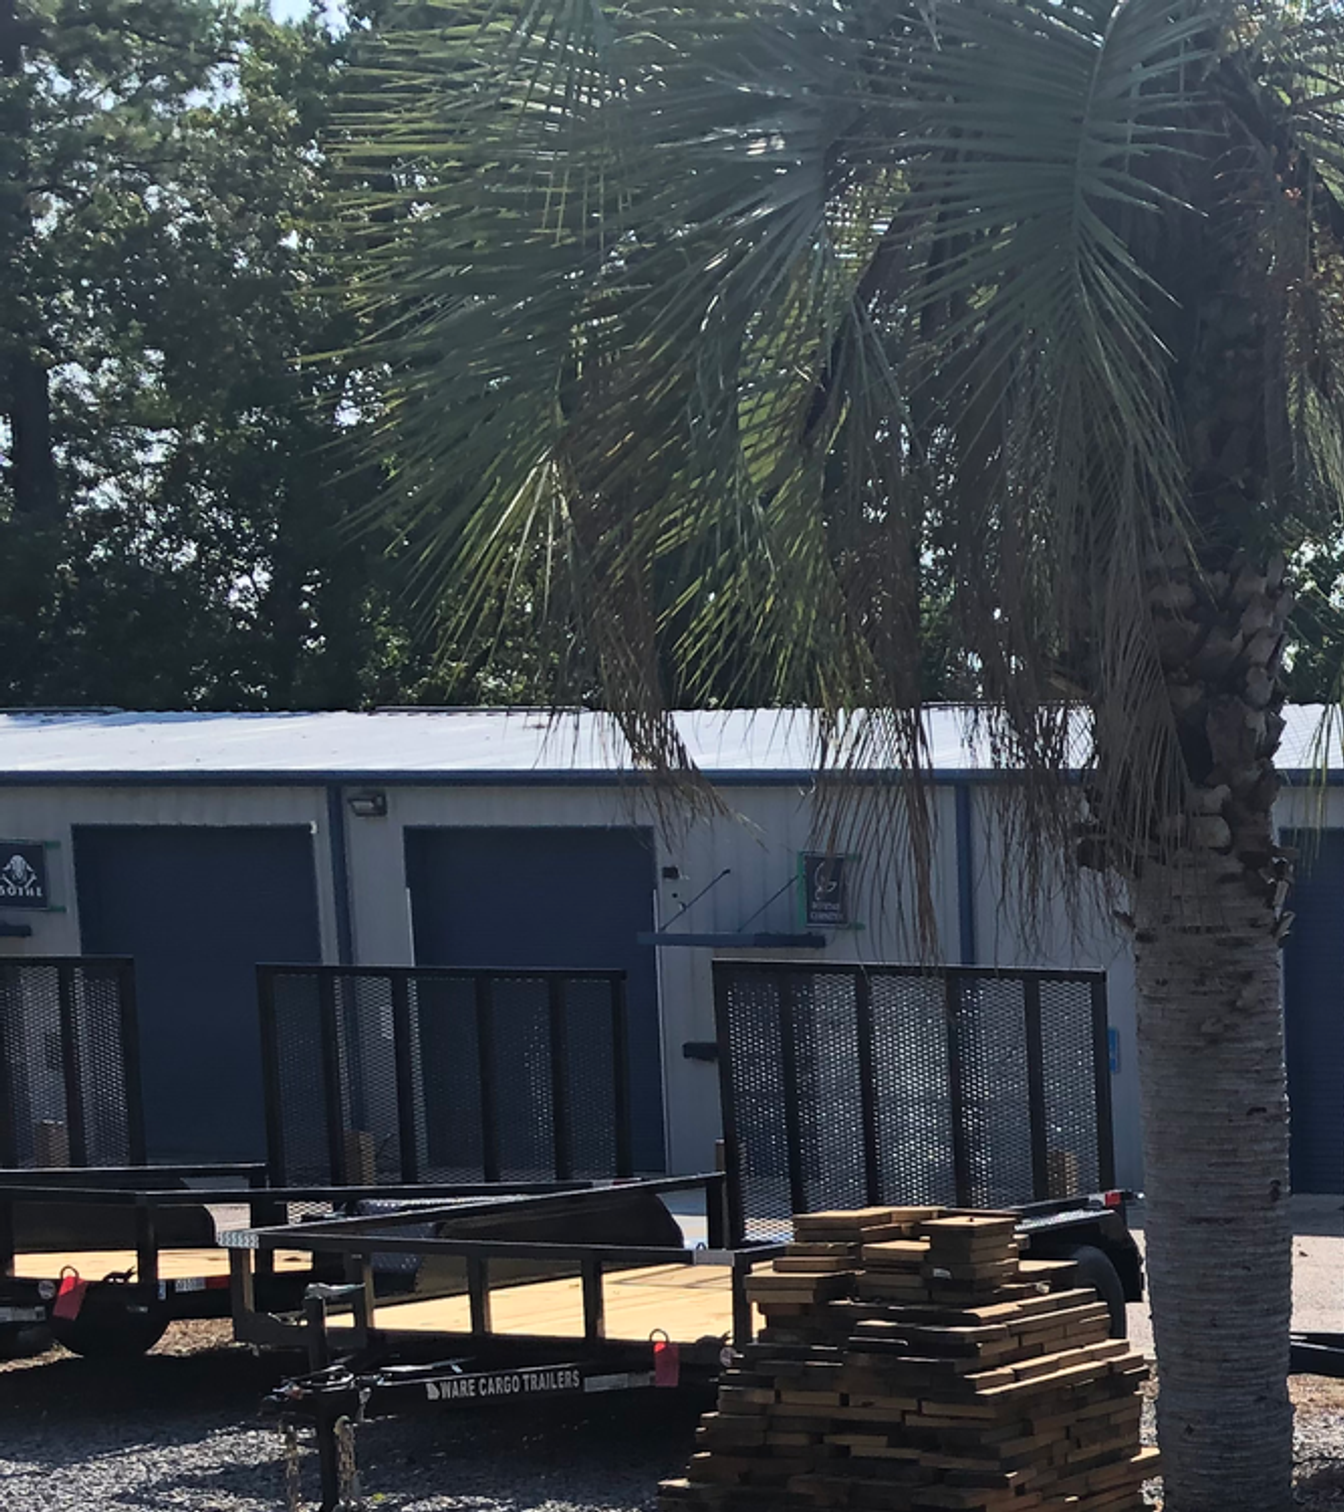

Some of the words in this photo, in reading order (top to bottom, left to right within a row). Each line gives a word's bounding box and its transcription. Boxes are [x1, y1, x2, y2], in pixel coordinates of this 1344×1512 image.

[440, 1379, 475, 1398] WARE
[479, 1375, 520, 1396] CARGO
[523, 1370, 579, 1391] TRAILERS
